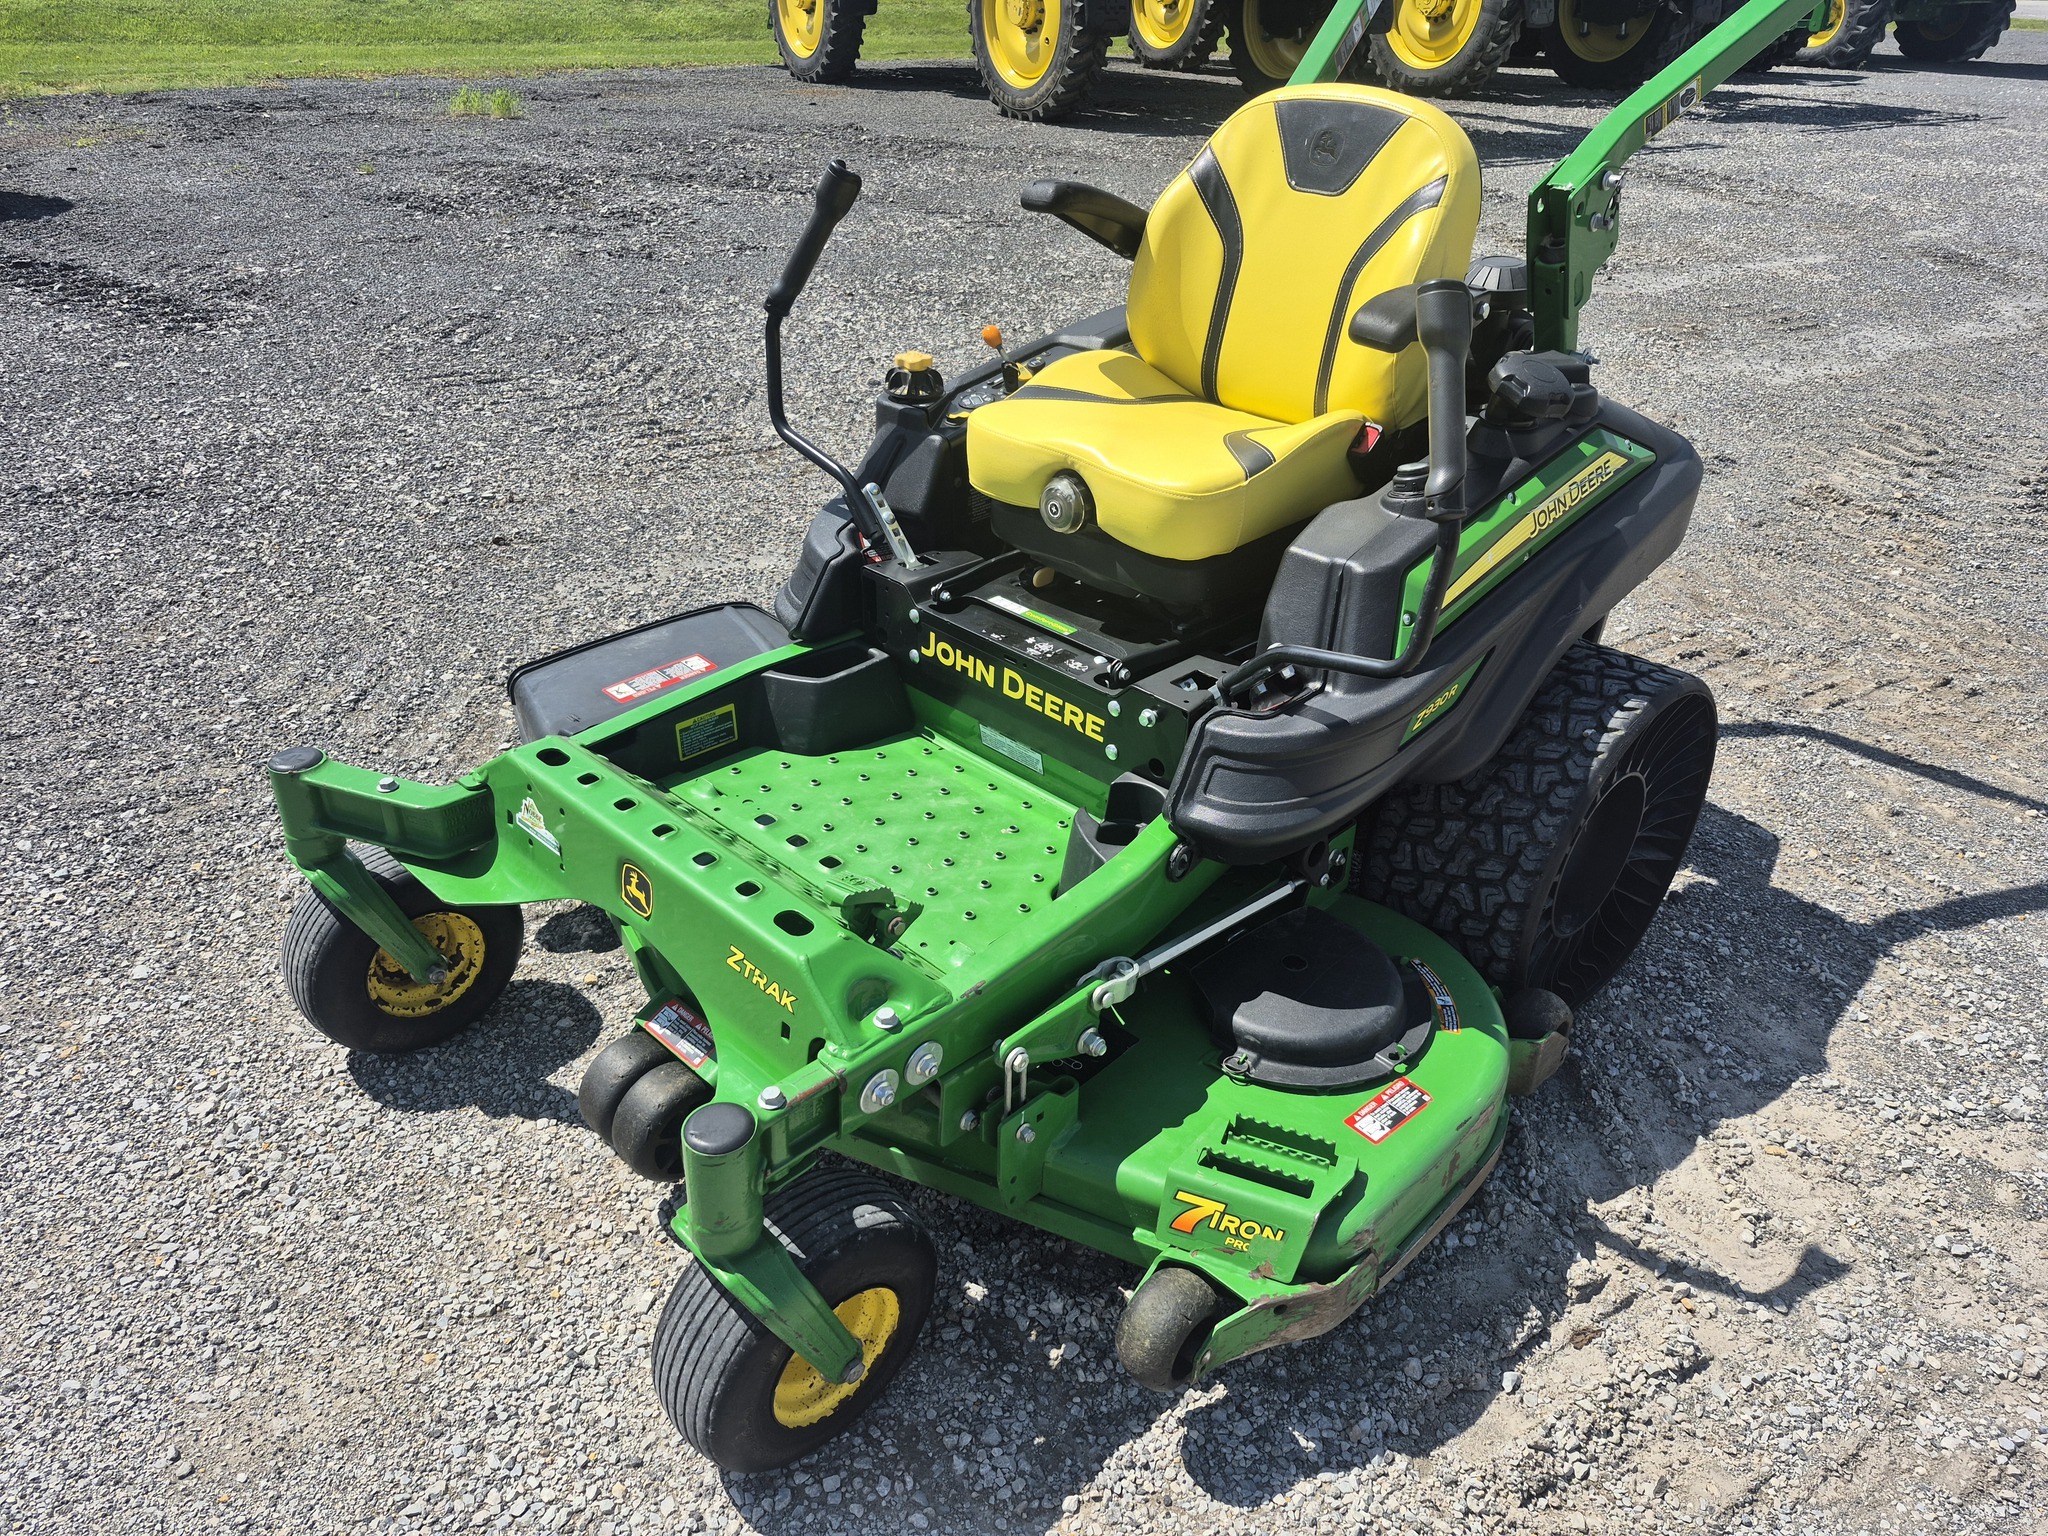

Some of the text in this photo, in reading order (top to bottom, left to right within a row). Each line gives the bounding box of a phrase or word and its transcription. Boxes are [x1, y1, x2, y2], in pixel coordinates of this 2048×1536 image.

[1530, 458, 1612, 535] JOHN DEERE
[921, 631, 1105, 743] JOHN DEERE
[1411, 683, 1459, 732] Z930R
[725, 944, 799, 1015] ZTRAK
[1168, 1188, 1286, 1242] 7 IRON
